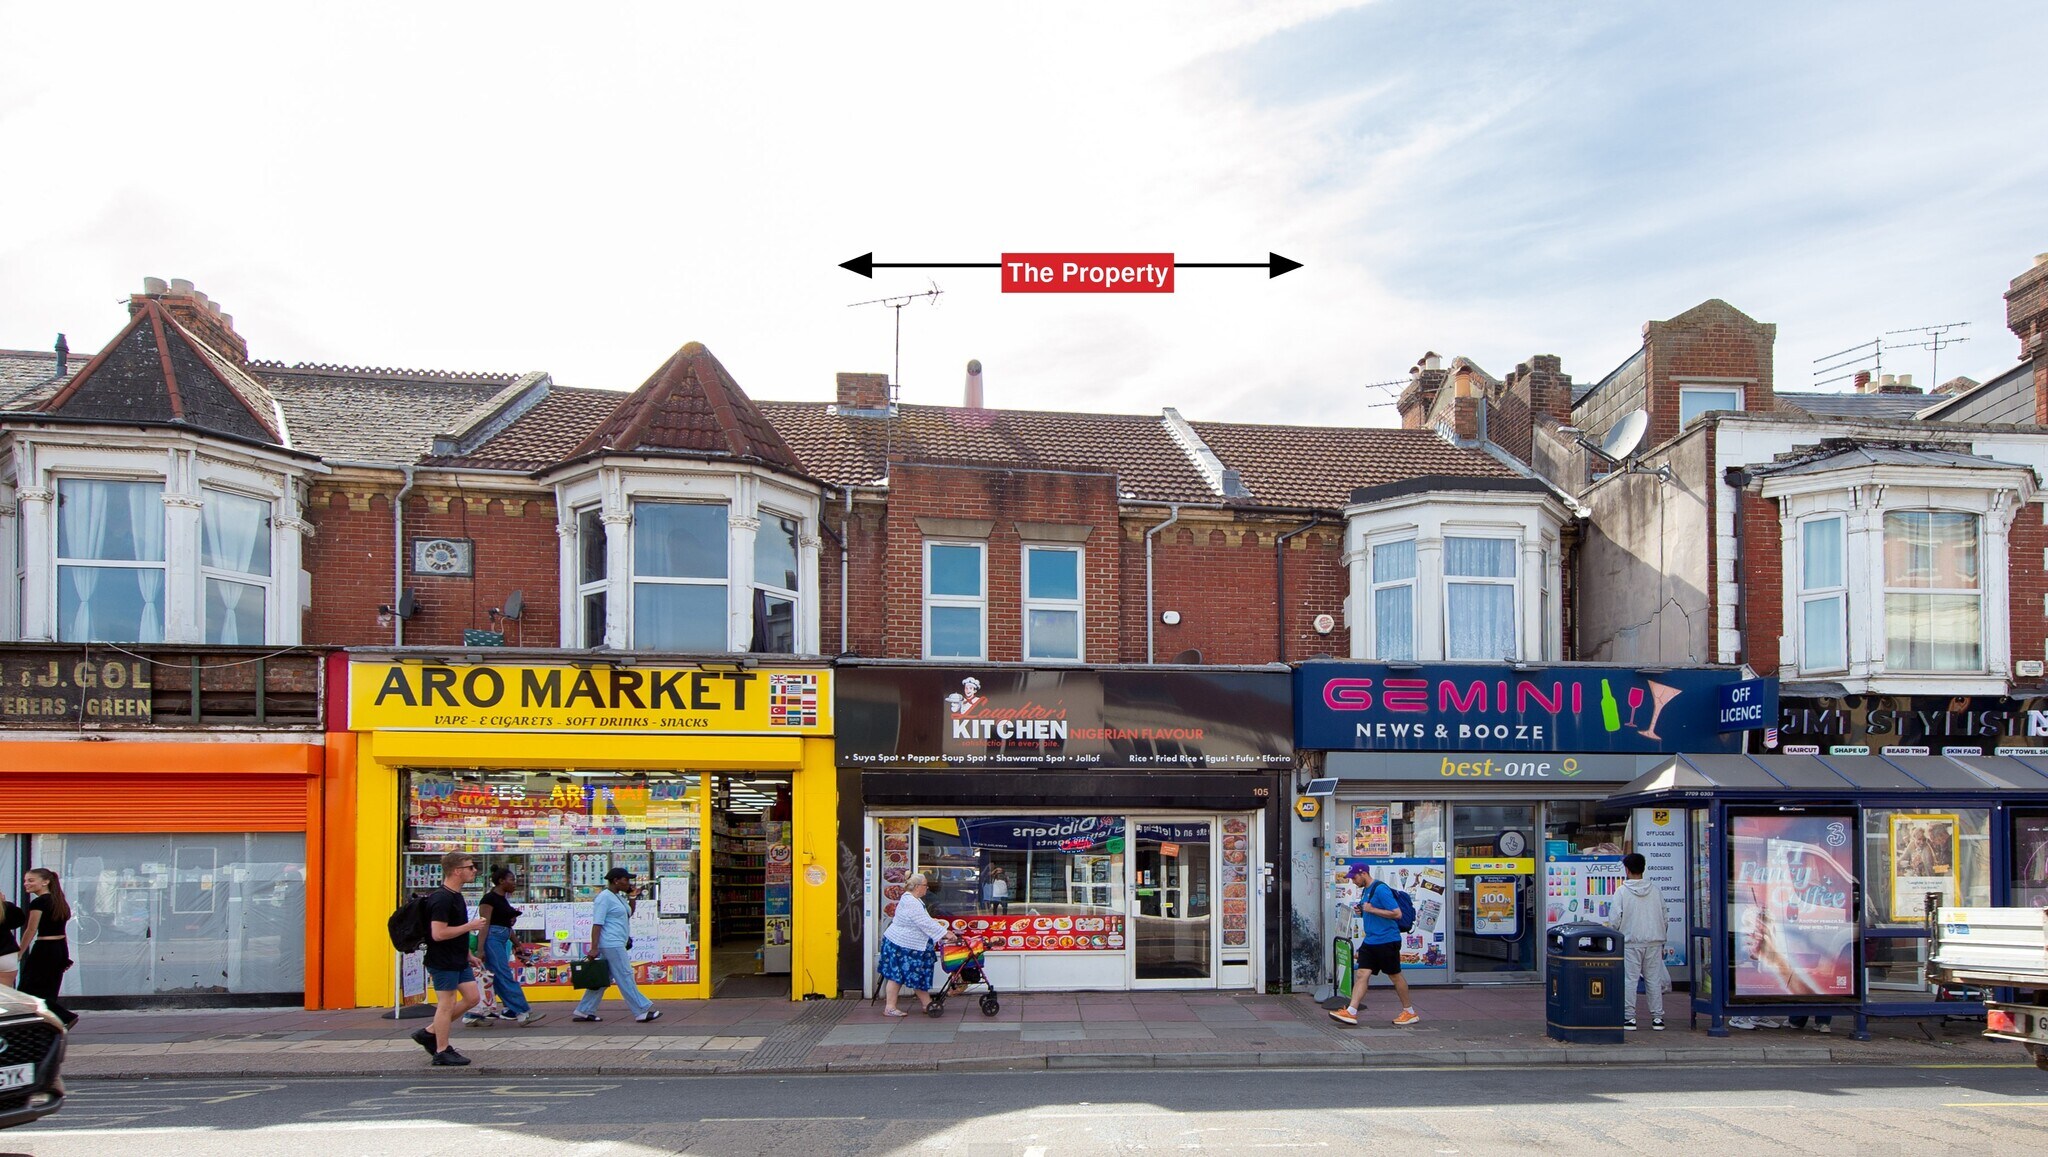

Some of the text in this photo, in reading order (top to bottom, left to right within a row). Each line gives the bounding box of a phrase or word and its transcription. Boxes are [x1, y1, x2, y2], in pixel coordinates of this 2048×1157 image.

[374, 666, 757, 711] ARO MARKET
[1323, 678, 1582, 714] GEMINI
[1731, 687, 1751, 703] OFF
[87, 699, 151, 716] GREEN
[950, 696, 1067, 722] Laughter's
[1720, 704, 1762, 723] LICENCE
[434, 715, 468, 726] VAPE
[566, 717, 597, 727] SOFT
[599, 717, 649, 727] DRINKS
[660, 718, 708, 728] SNACKS
[952, 719, 1204, 740] KITCHEN NIGERIAN FLAVOUR
[1356, 723, 1544, 740] NEWS & BOOZE
[852, 753, 1291, 765] Suya Spot Pepper Soup Spot Shawarma Spot Jollof Rice Fried Rice Egusi Fufu Eforiro
[1440, 757, 1551, 777] best-one
[1253, 788, 1269, 796] 105
[1586, 864, 1621, 872] VAPES
[1738, 861, 1812, 889] Fancy
[1771, 885, 1846, 914] Coffee
